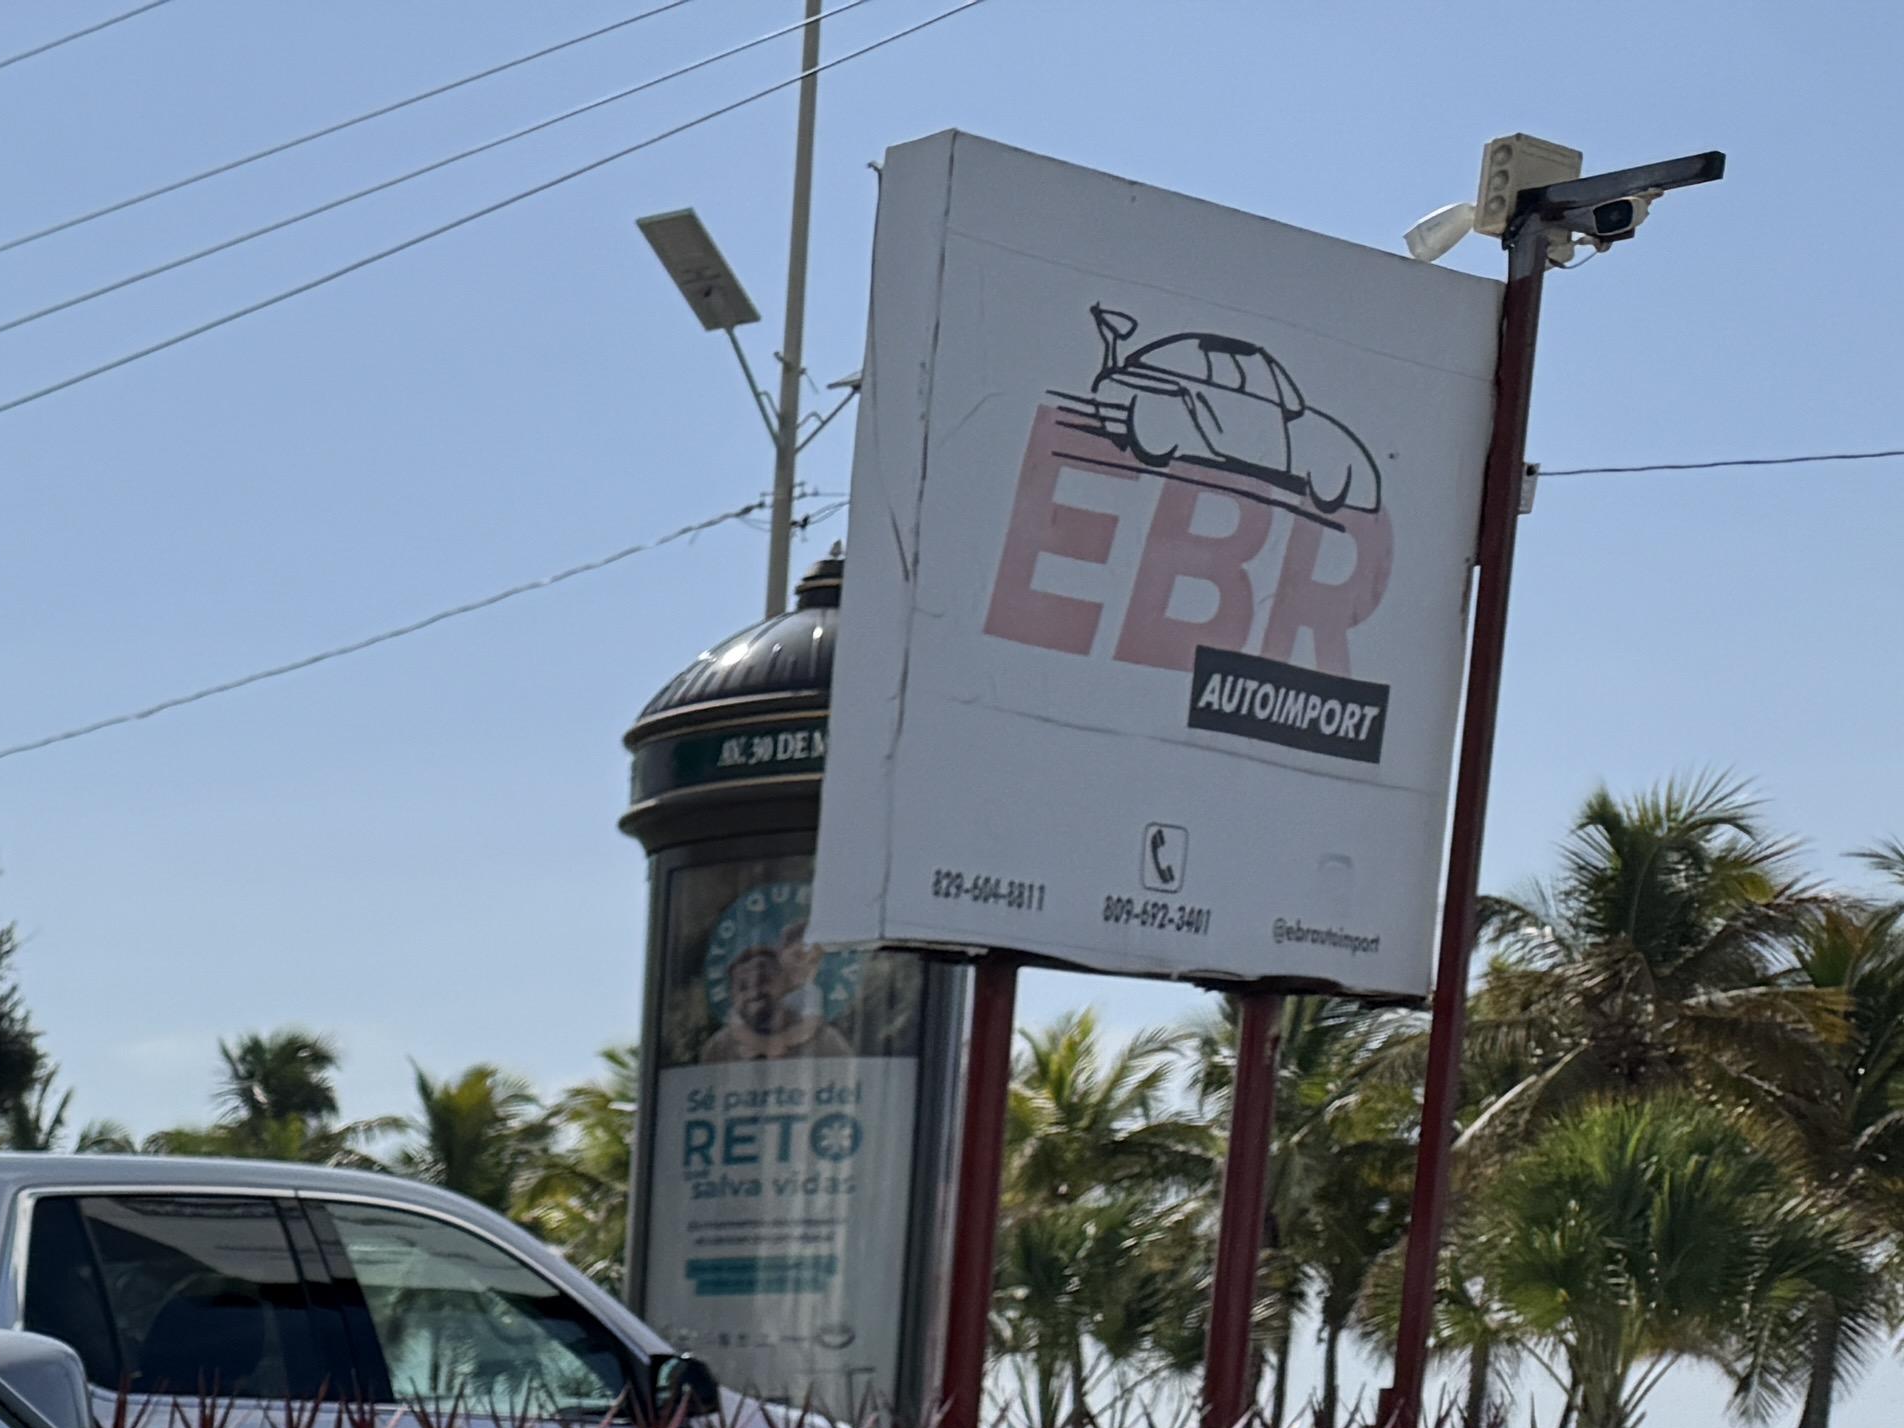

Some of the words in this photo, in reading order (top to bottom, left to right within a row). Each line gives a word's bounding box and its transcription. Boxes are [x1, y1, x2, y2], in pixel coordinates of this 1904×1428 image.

[983, 404, 1394, 679] EBR
[1198, 672, 1381, 741] AUTOIMPORT
[776, 731, 810, 761] DE
[933, 868, 1045, 911] 829-604-8811
[723, 1086, 805, 1112] parte
[815, 1082, 863, 1105] del
[683, 1112, 863, 1166] RETO
[692, 1173, 763, 1200] salva
[772, 1169, 858, 1196] vidas
